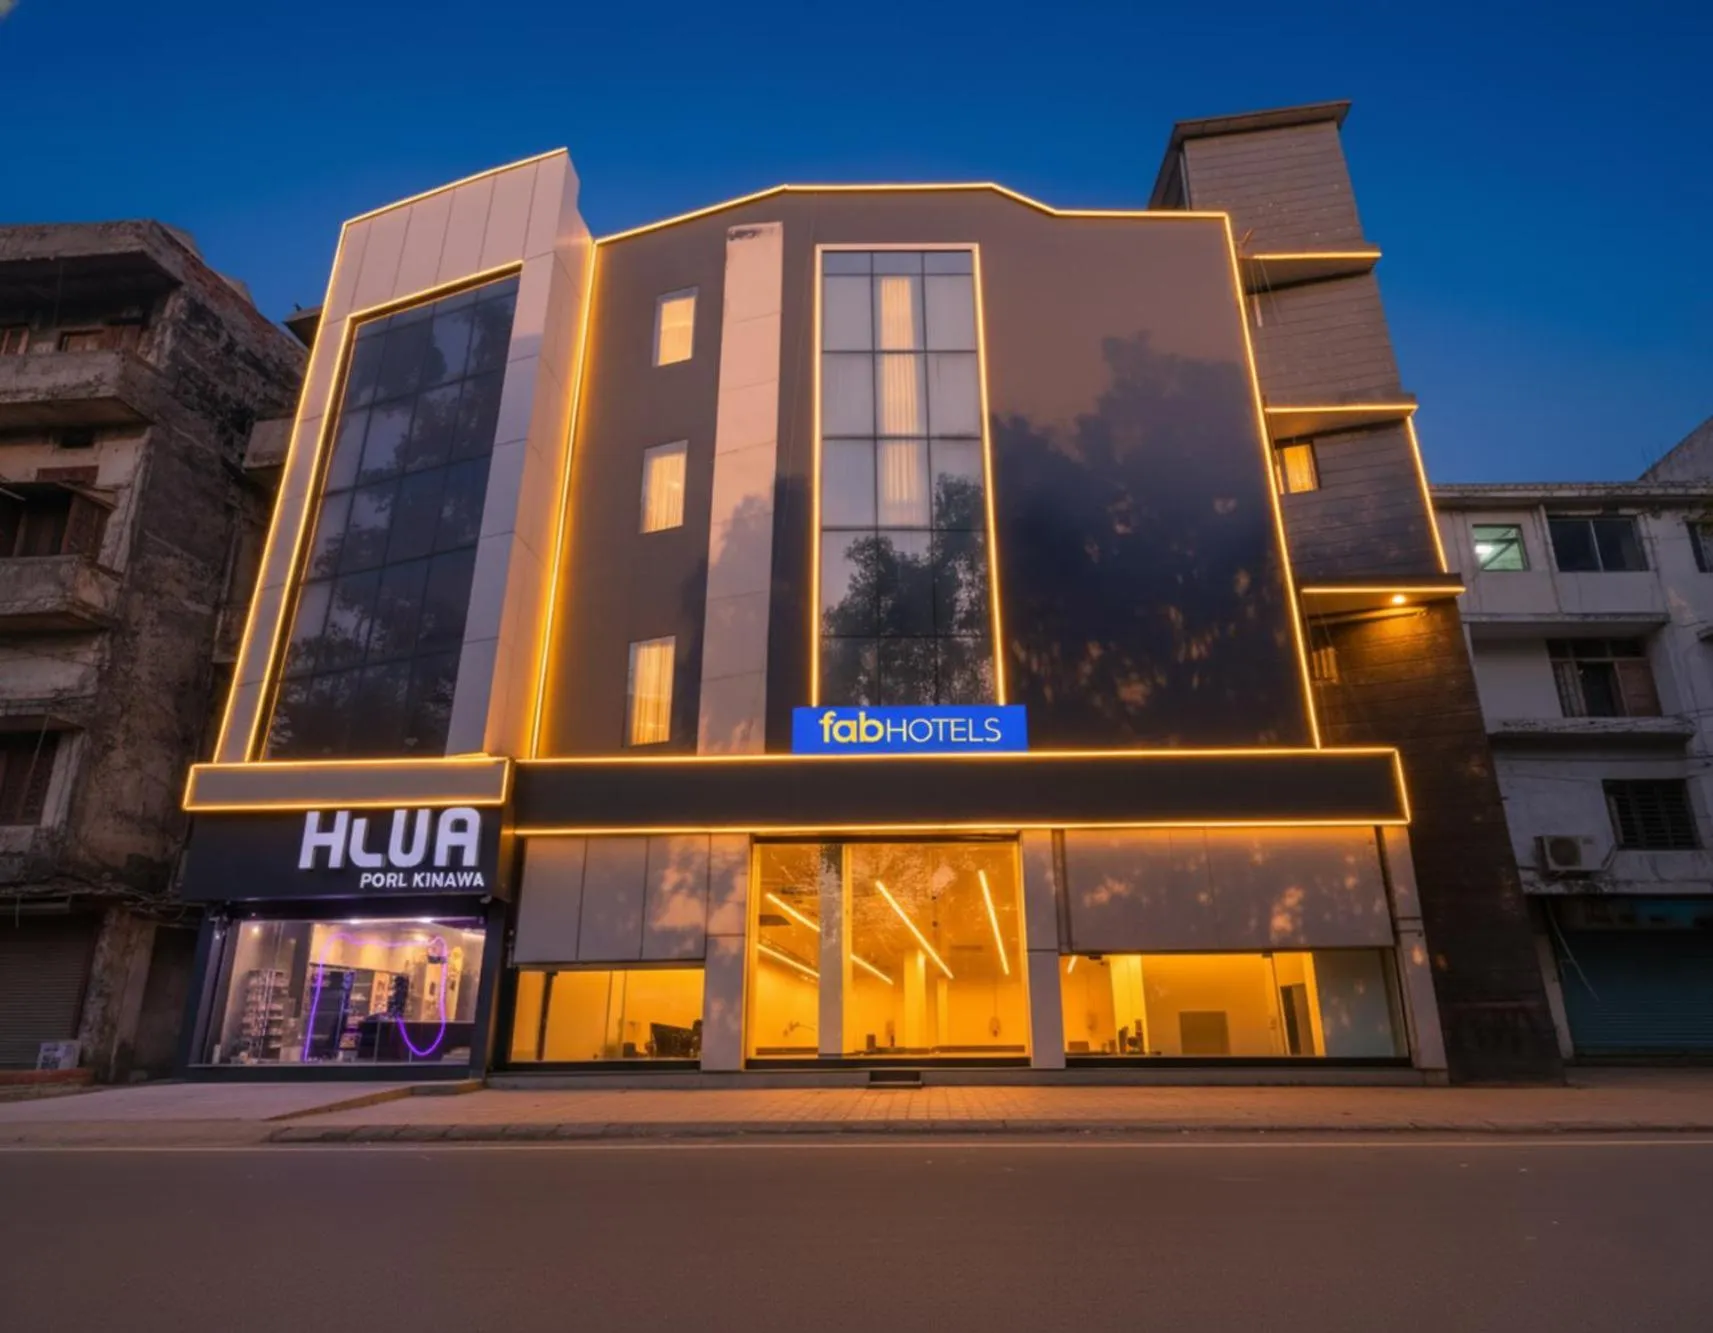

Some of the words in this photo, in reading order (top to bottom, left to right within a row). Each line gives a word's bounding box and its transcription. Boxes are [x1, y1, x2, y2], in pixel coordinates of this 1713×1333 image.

[819, 711, 1002, 743] fabHOTELS
[359, 872, 407, 888] PORL
[412, 871, 485, 888] KINAWA
